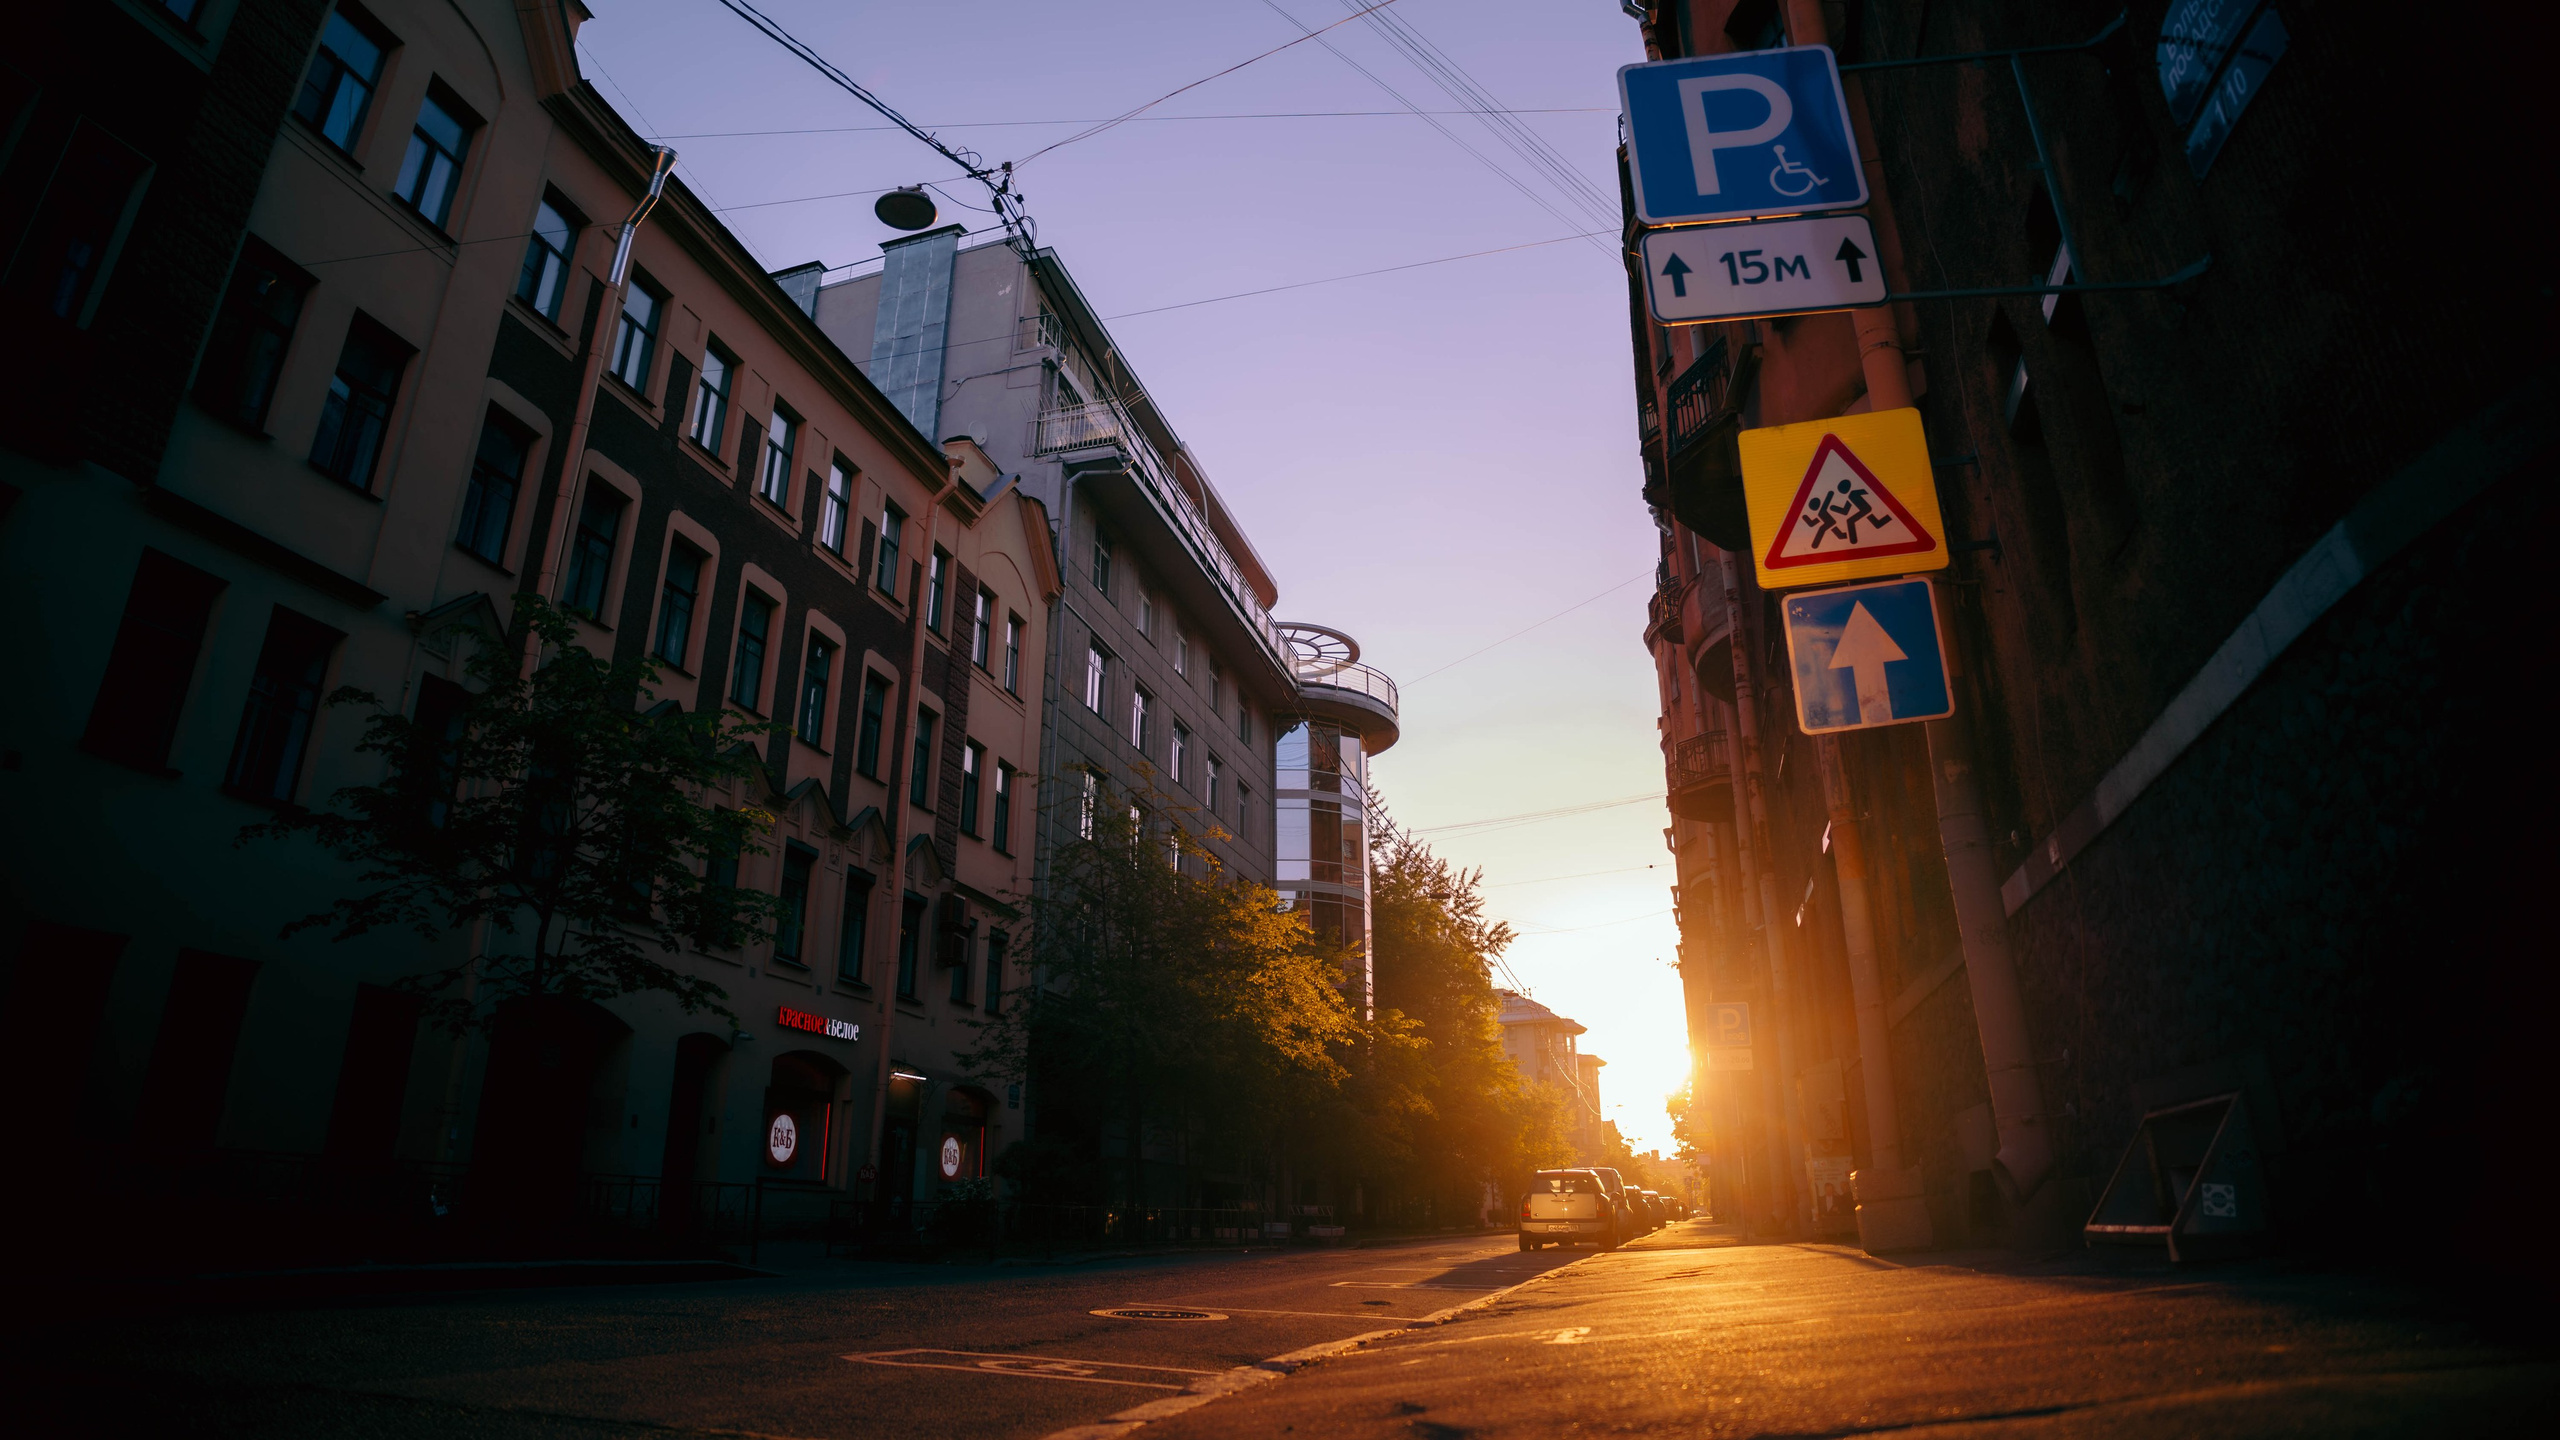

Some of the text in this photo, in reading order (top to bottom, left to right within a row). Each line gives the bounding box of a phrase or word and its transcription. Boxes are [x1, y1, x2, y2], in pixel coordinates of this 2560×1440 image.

[2168, 0, 2224, 92] ПОСАДС
[2214, 67, 2248, 125] 1/10
[1677, 73, 1794, 196] P
[1718, 1008, 1741, 1042] P
[772, 1127, 793, 1149] К&Б
